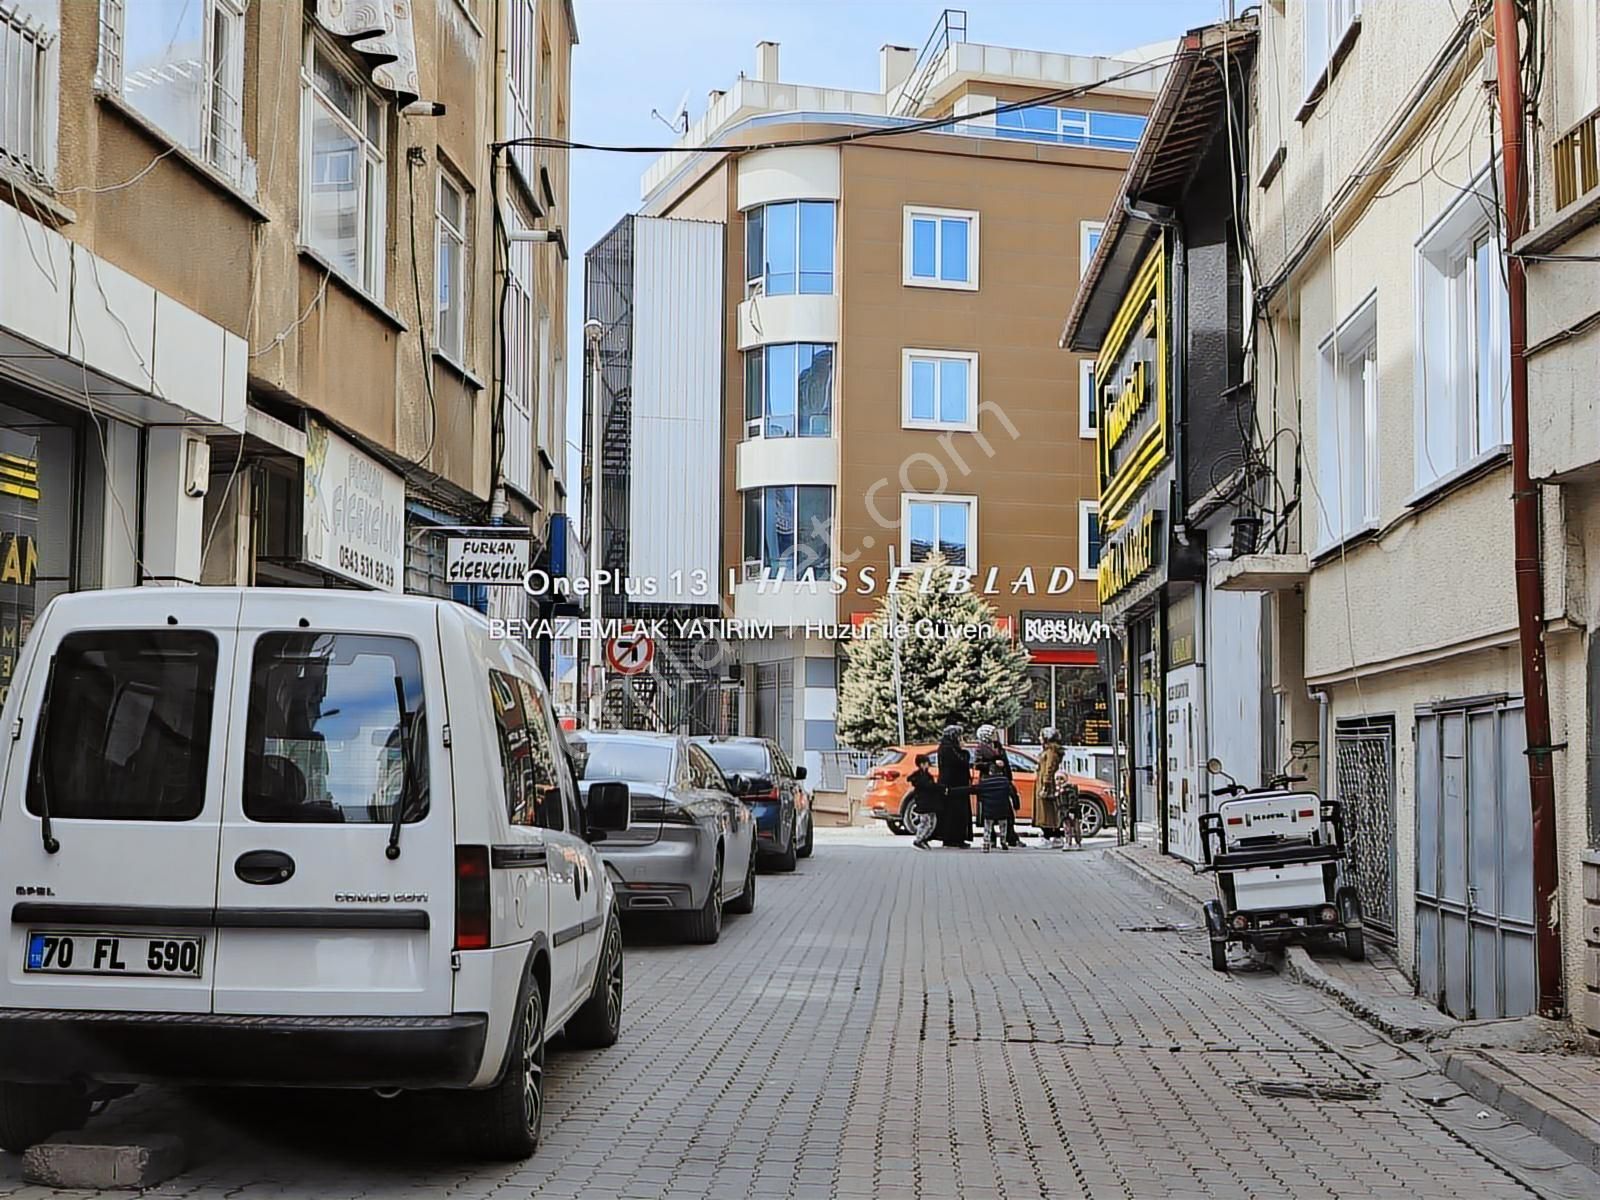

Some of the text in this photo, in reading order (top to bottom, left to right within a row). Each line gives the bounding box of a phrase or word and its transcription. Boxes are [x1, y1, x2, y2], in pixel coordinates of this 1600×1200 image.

[463, 541, 516, 555] FURKAN
[449, 555, 526, 582] ÇİÇEKÇİLİK
[43, 937, 74, 969] 70
[93, 939, 126, 970] FL
[147, 940, 198, 972] 590
